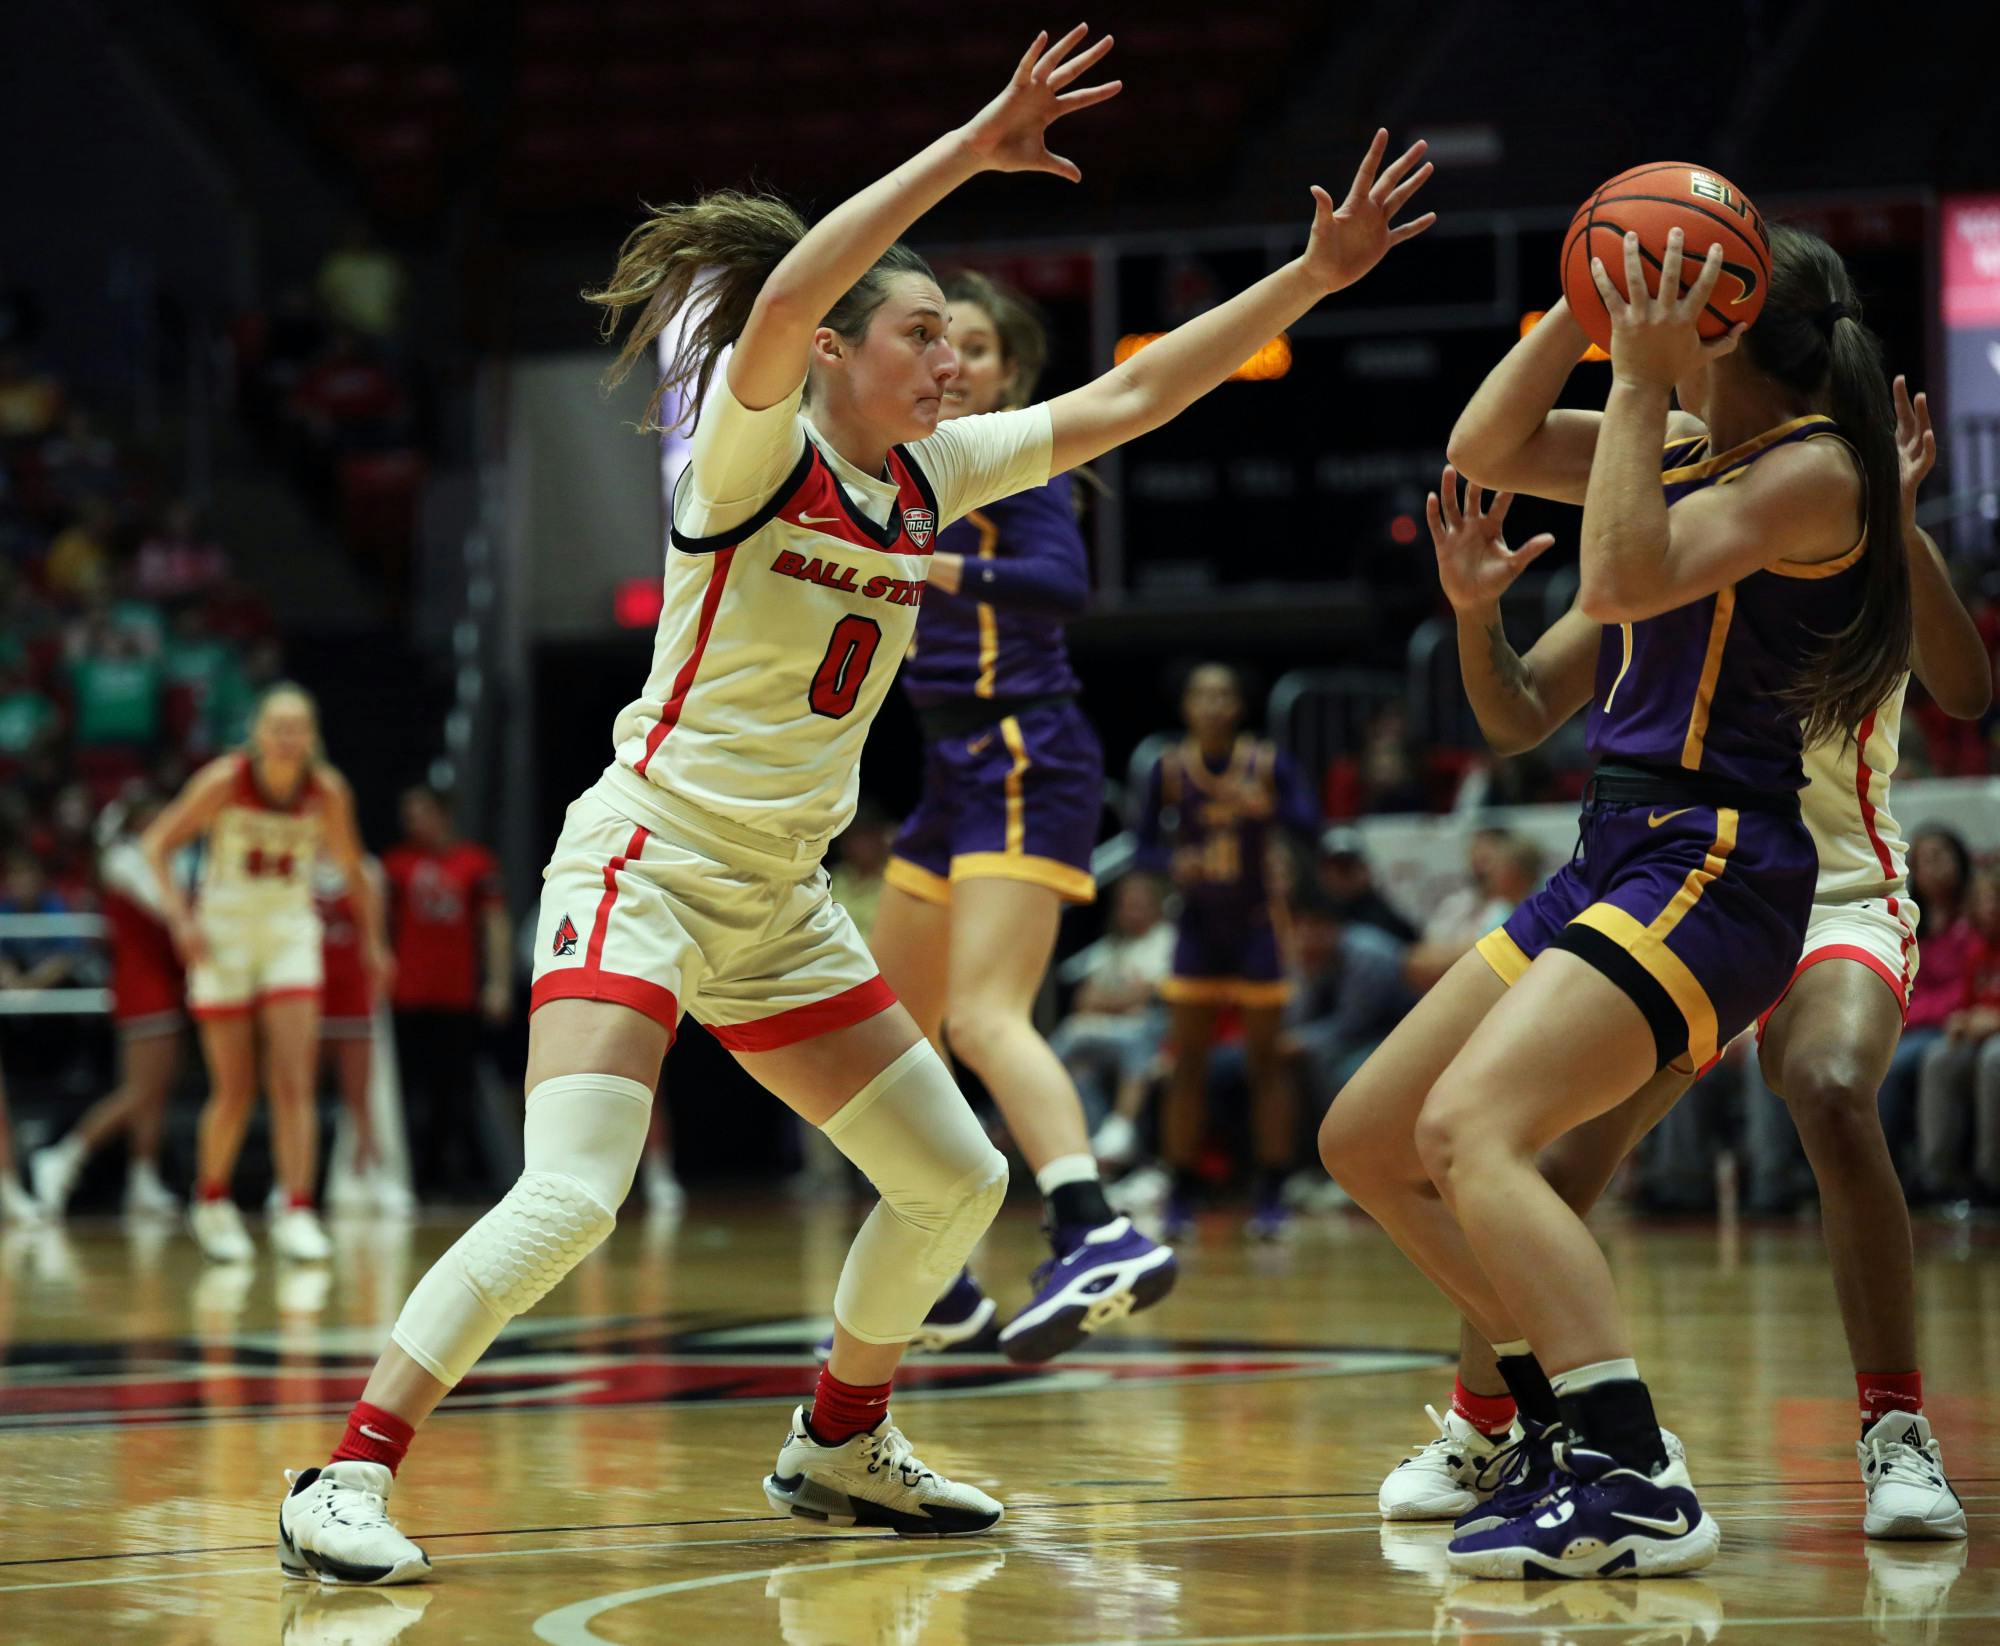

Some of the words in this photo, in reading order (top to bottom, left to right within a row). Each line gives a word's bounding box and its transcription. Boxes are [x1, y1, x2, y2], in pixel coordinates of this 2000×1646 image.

[906, 520, 932, 531] MAC
[770, 550, 859, 593] BALL
[808, 613, 882, 720] 0
